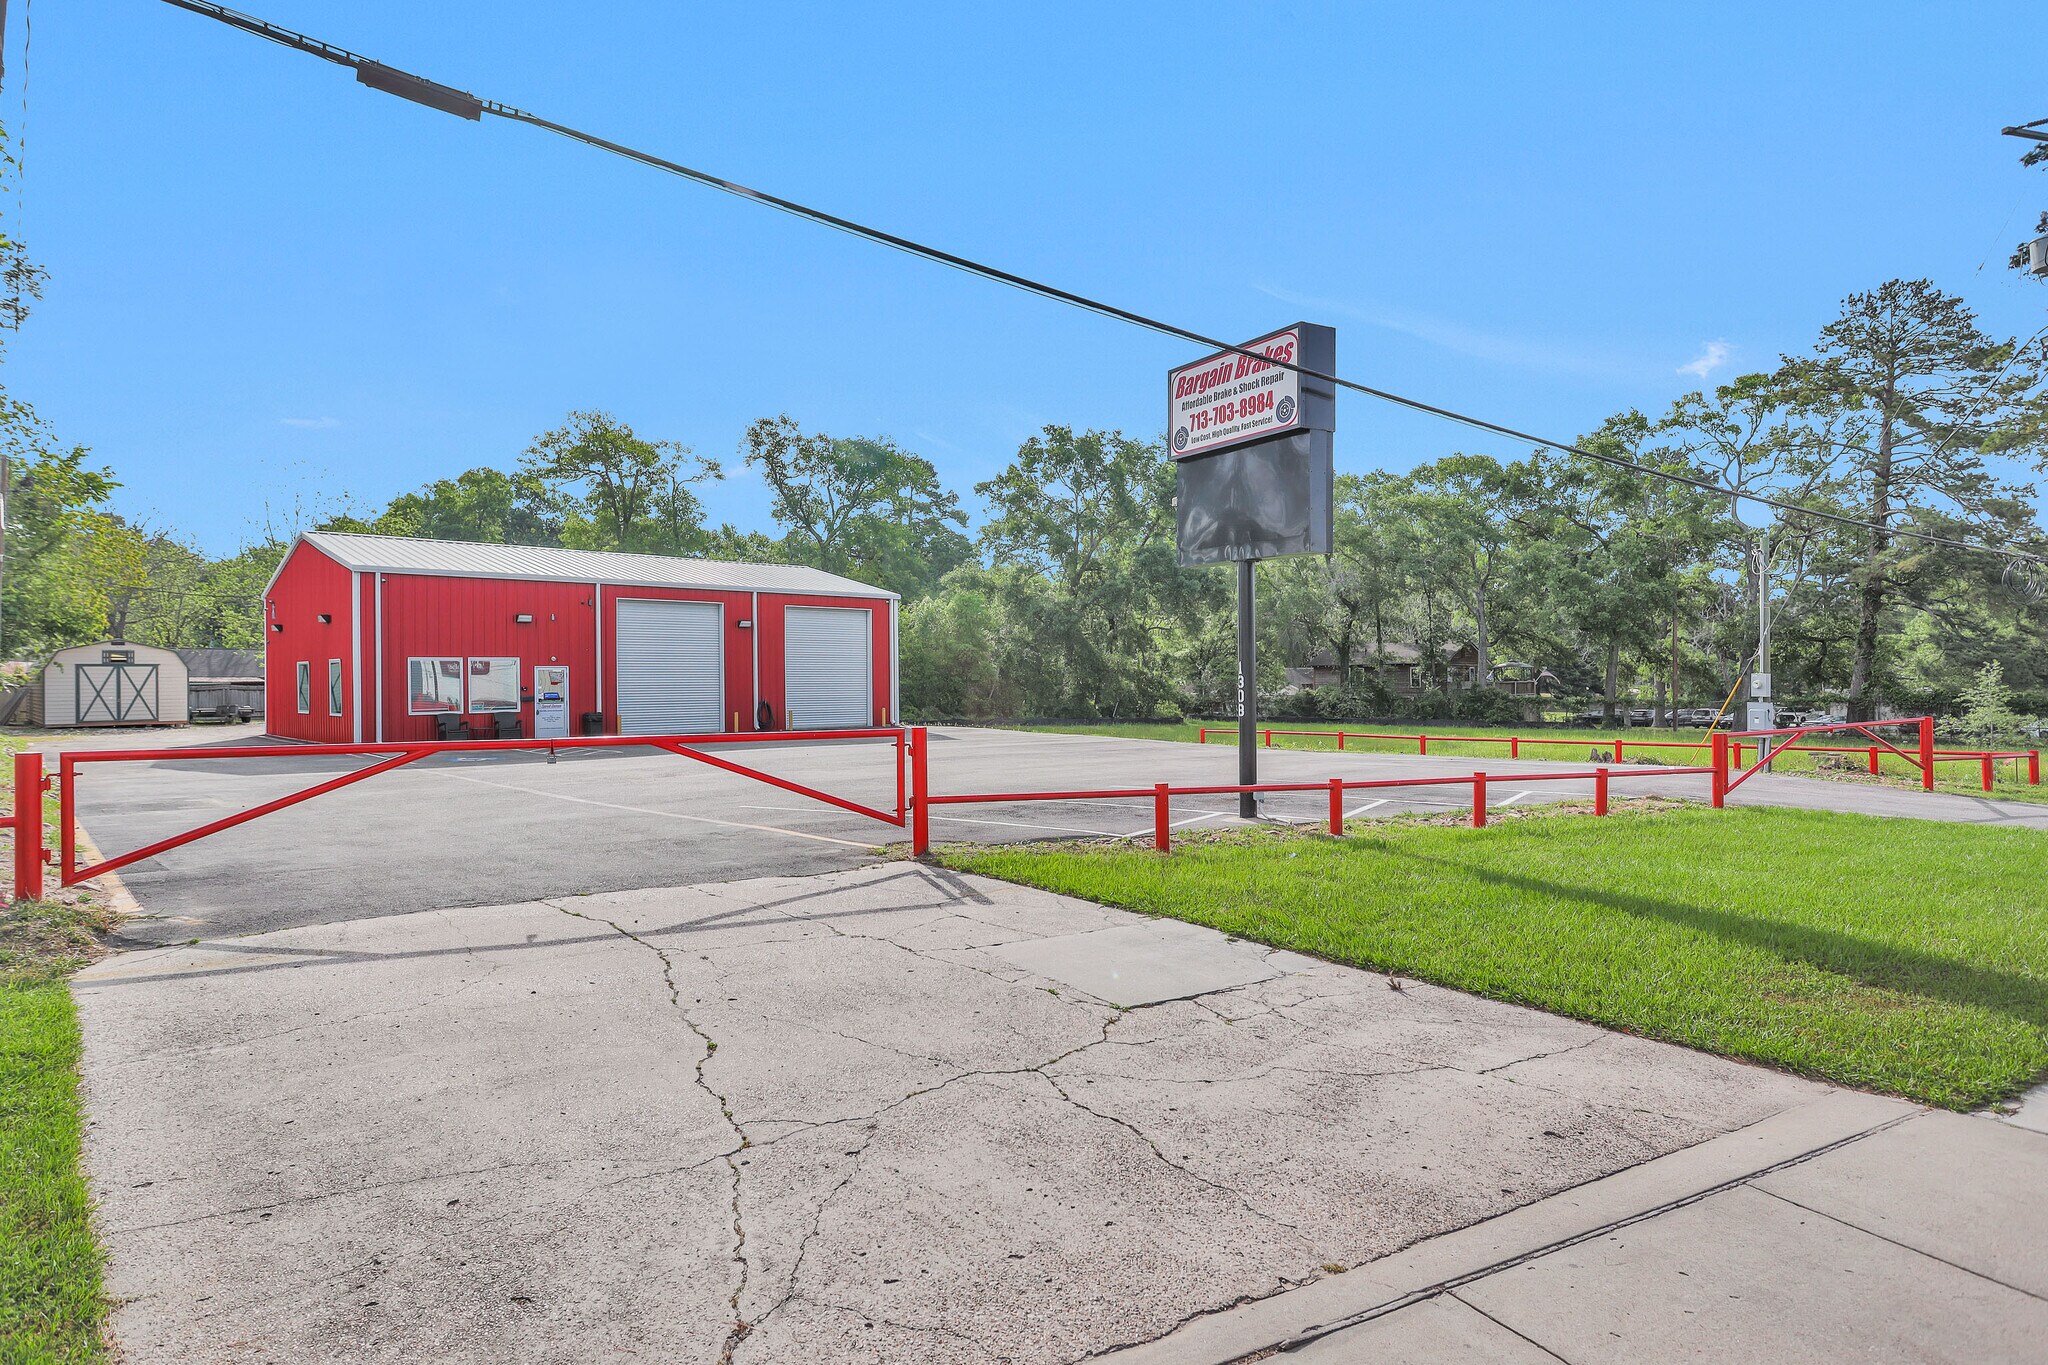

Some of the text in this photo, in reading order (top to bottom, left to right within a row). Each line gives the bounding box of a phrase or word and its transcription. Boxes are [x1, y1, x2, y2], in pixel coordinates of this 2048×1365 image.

[1175, 342, 1294, 399] Bargain Brakes
[1181, 371, 1285, 411] Affordable Brake & Shock Repair
[1190, 390, 1274, 432] 713-703-8984
[1212, 429, 1222, 438] High
[1241, 422, 1252, 431] Fast
[1252, 415, 1273, 427] Service!
